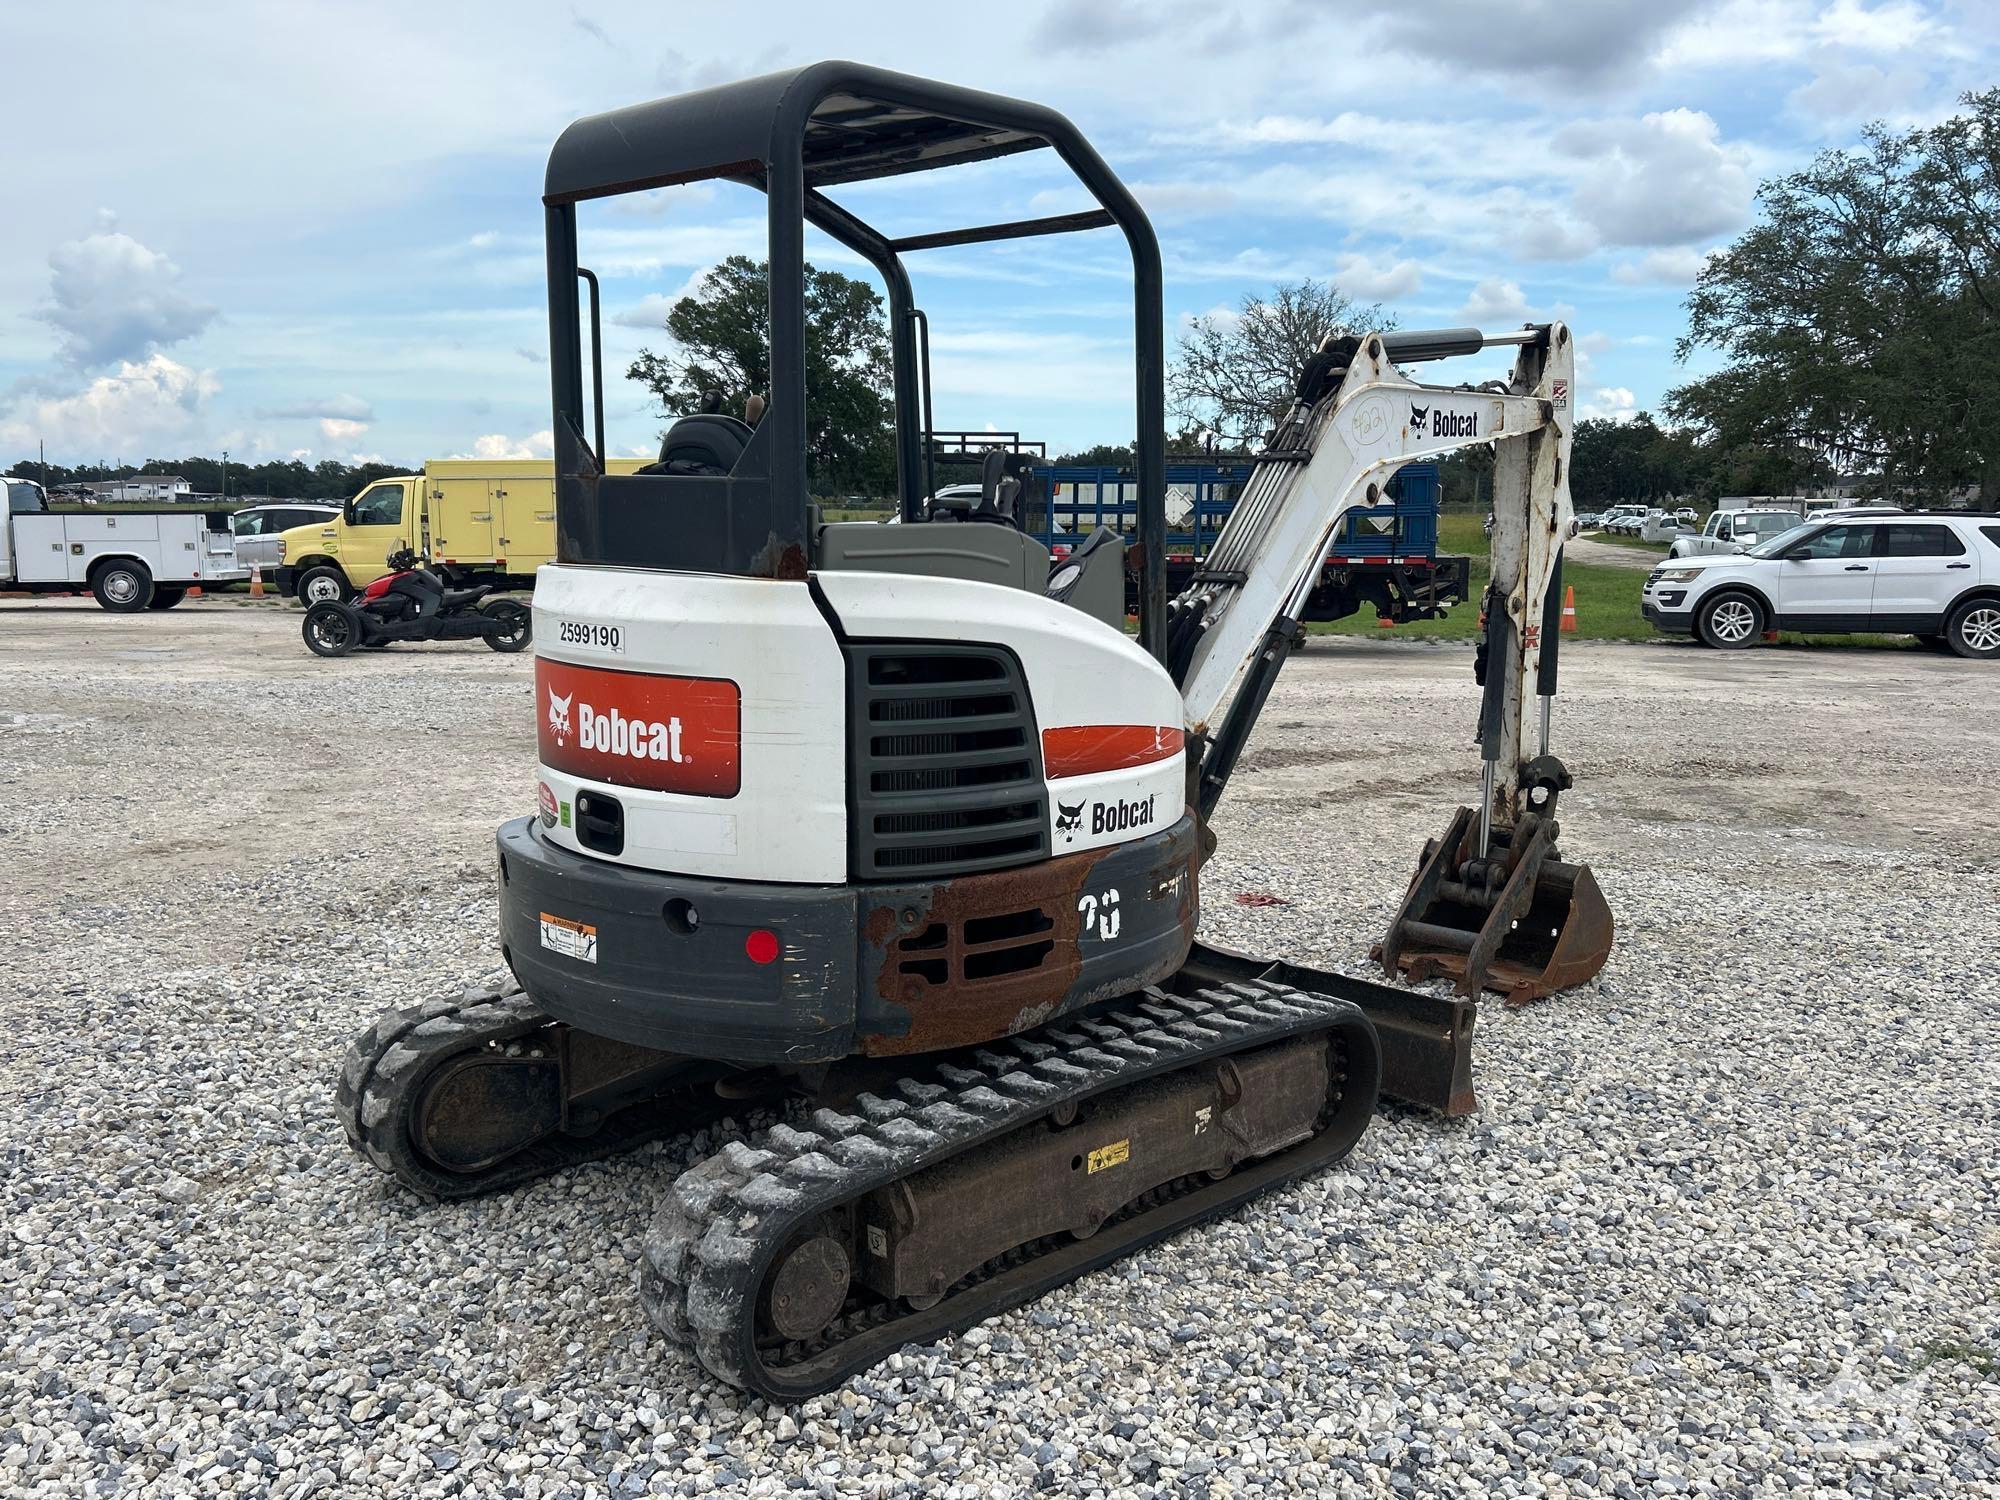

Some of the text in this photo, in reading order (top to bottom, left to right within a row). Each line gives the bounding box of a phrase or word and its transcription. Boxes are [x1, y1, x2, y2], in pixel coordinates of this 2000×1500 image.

[1433, 410, 1477, 437] Bobcat
[560, 621, 619, 647] 2599190
[578, 702, 683, 763] Bobcat
[1091, 794, 1154, 835] Bobcat
